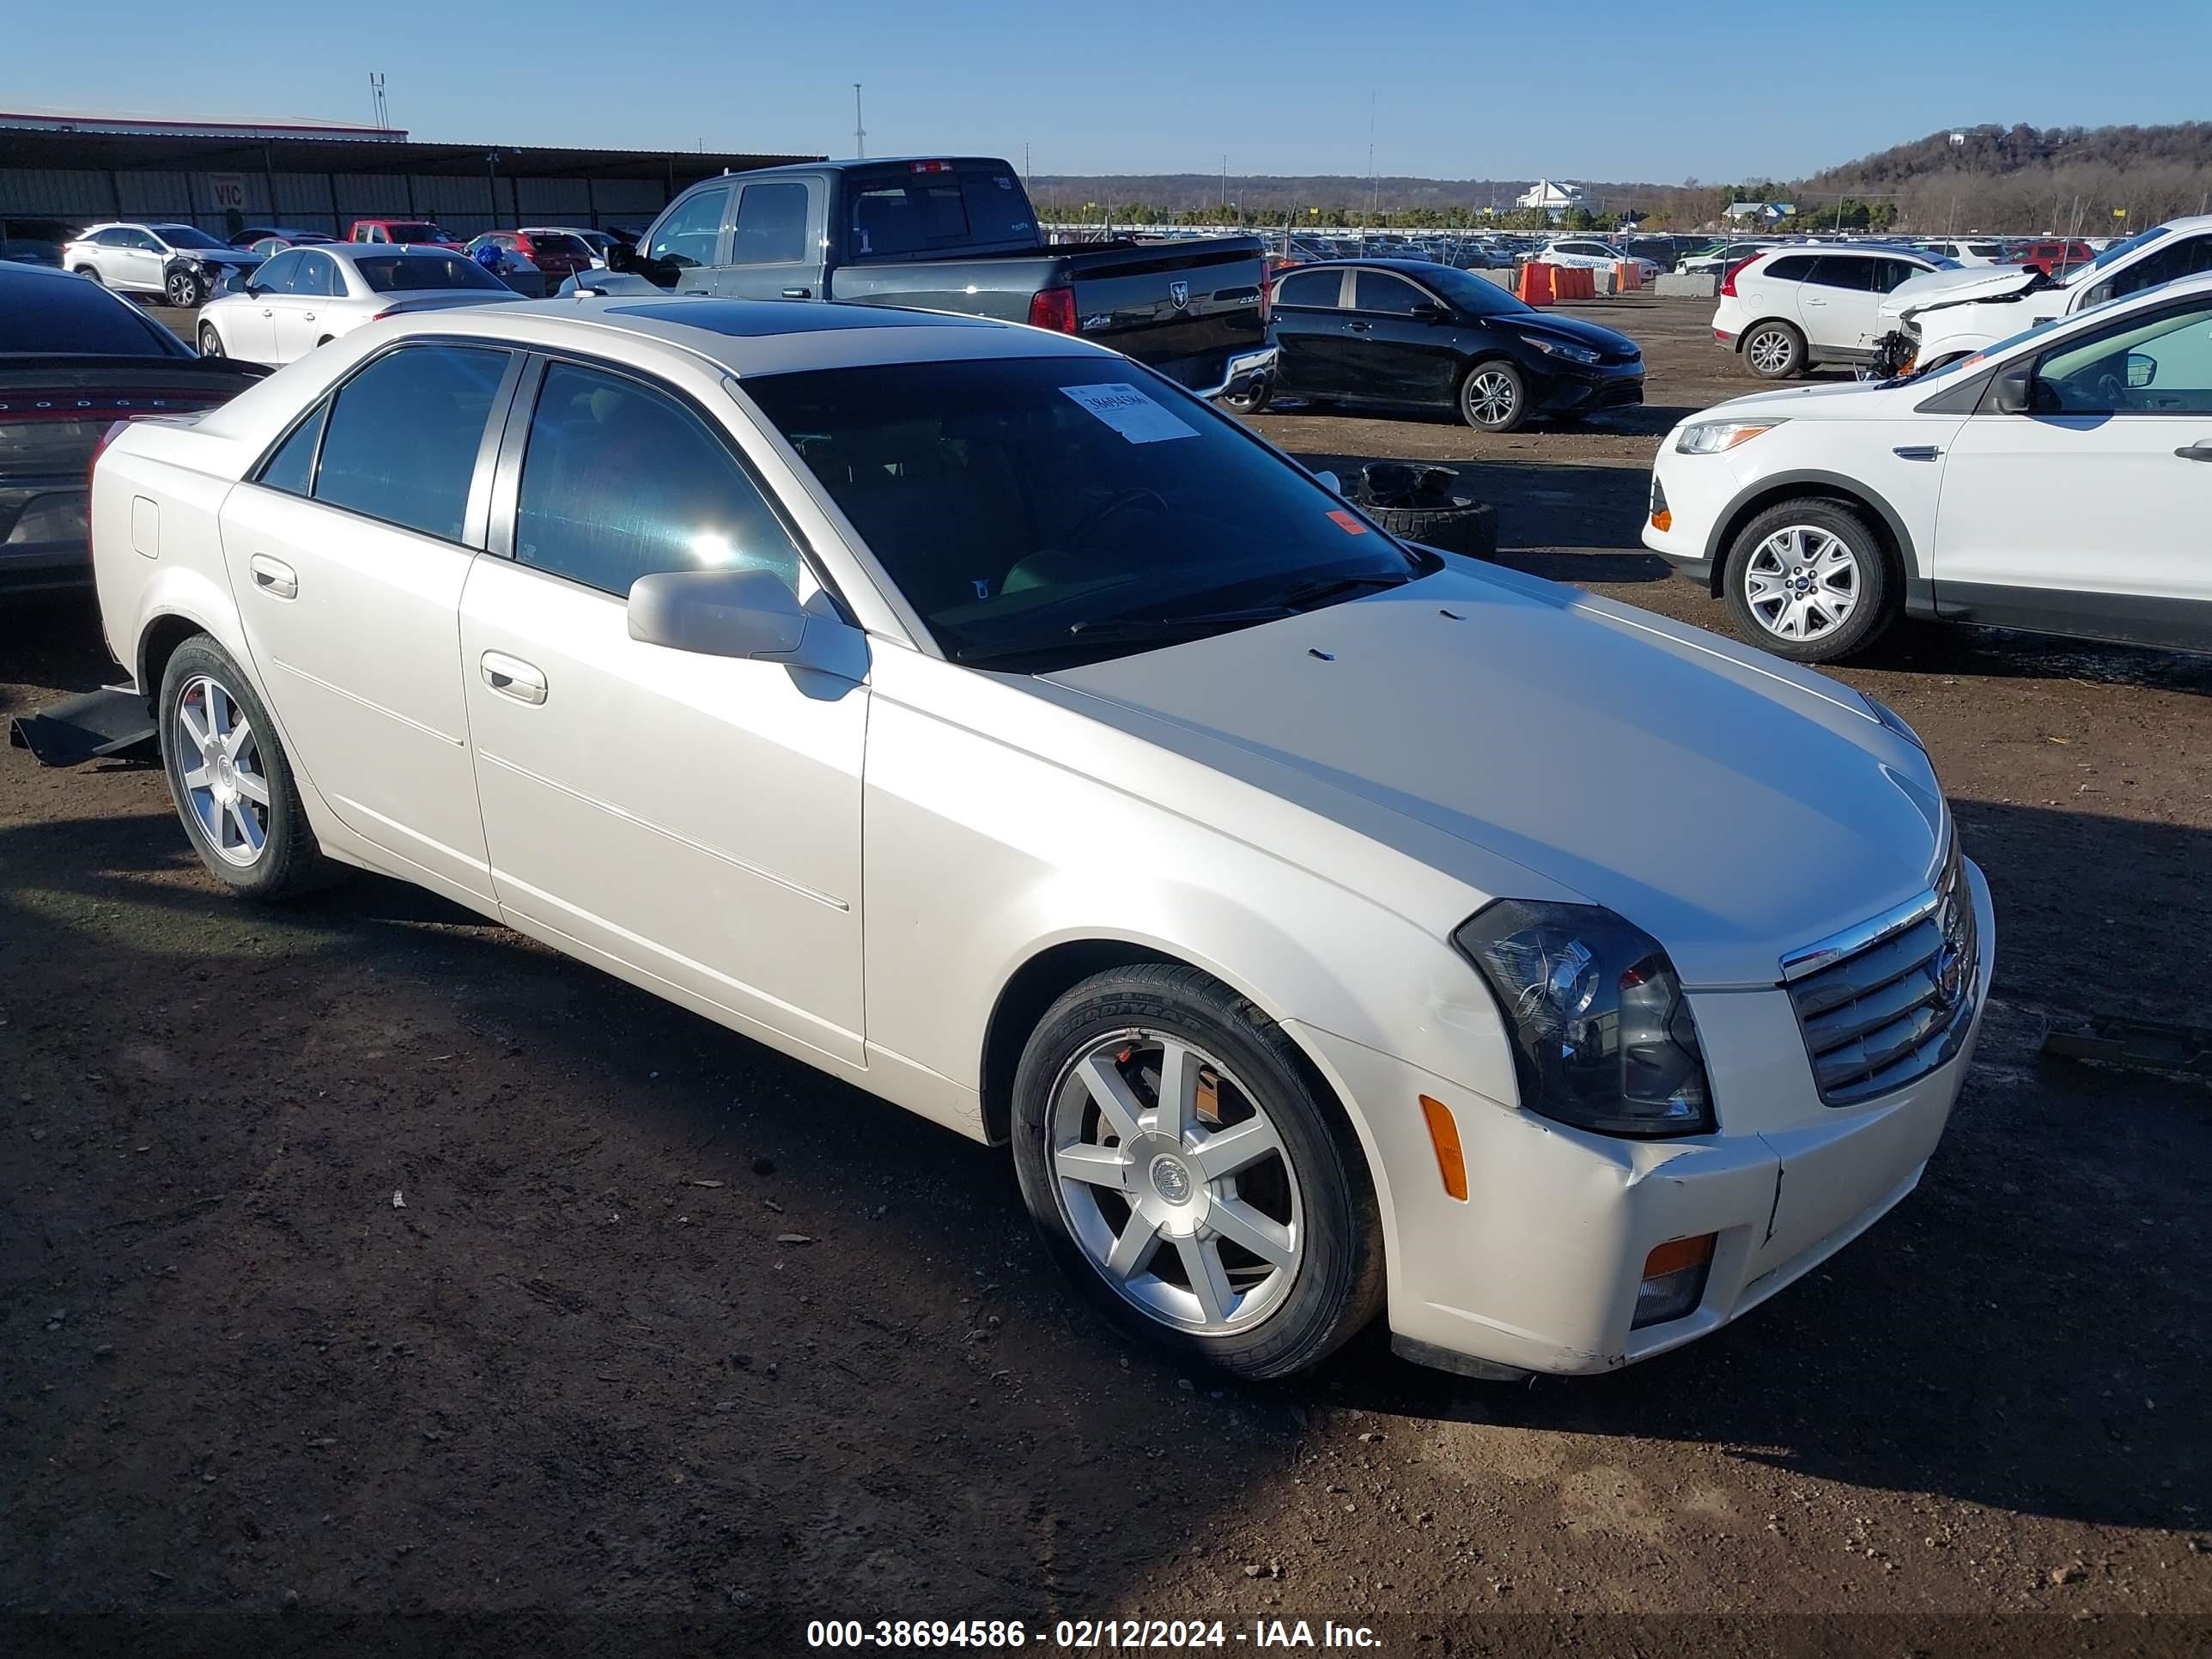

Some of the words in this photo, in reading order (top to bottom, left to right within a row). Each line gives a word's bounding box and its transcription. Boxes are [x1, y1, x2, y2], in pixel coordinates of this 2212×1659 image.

[214, 185, 241, 205] VIC
[1565, 259, 1610, 269] PROGRESSIVE
[1085, 394, 1149, 410] 38694586
